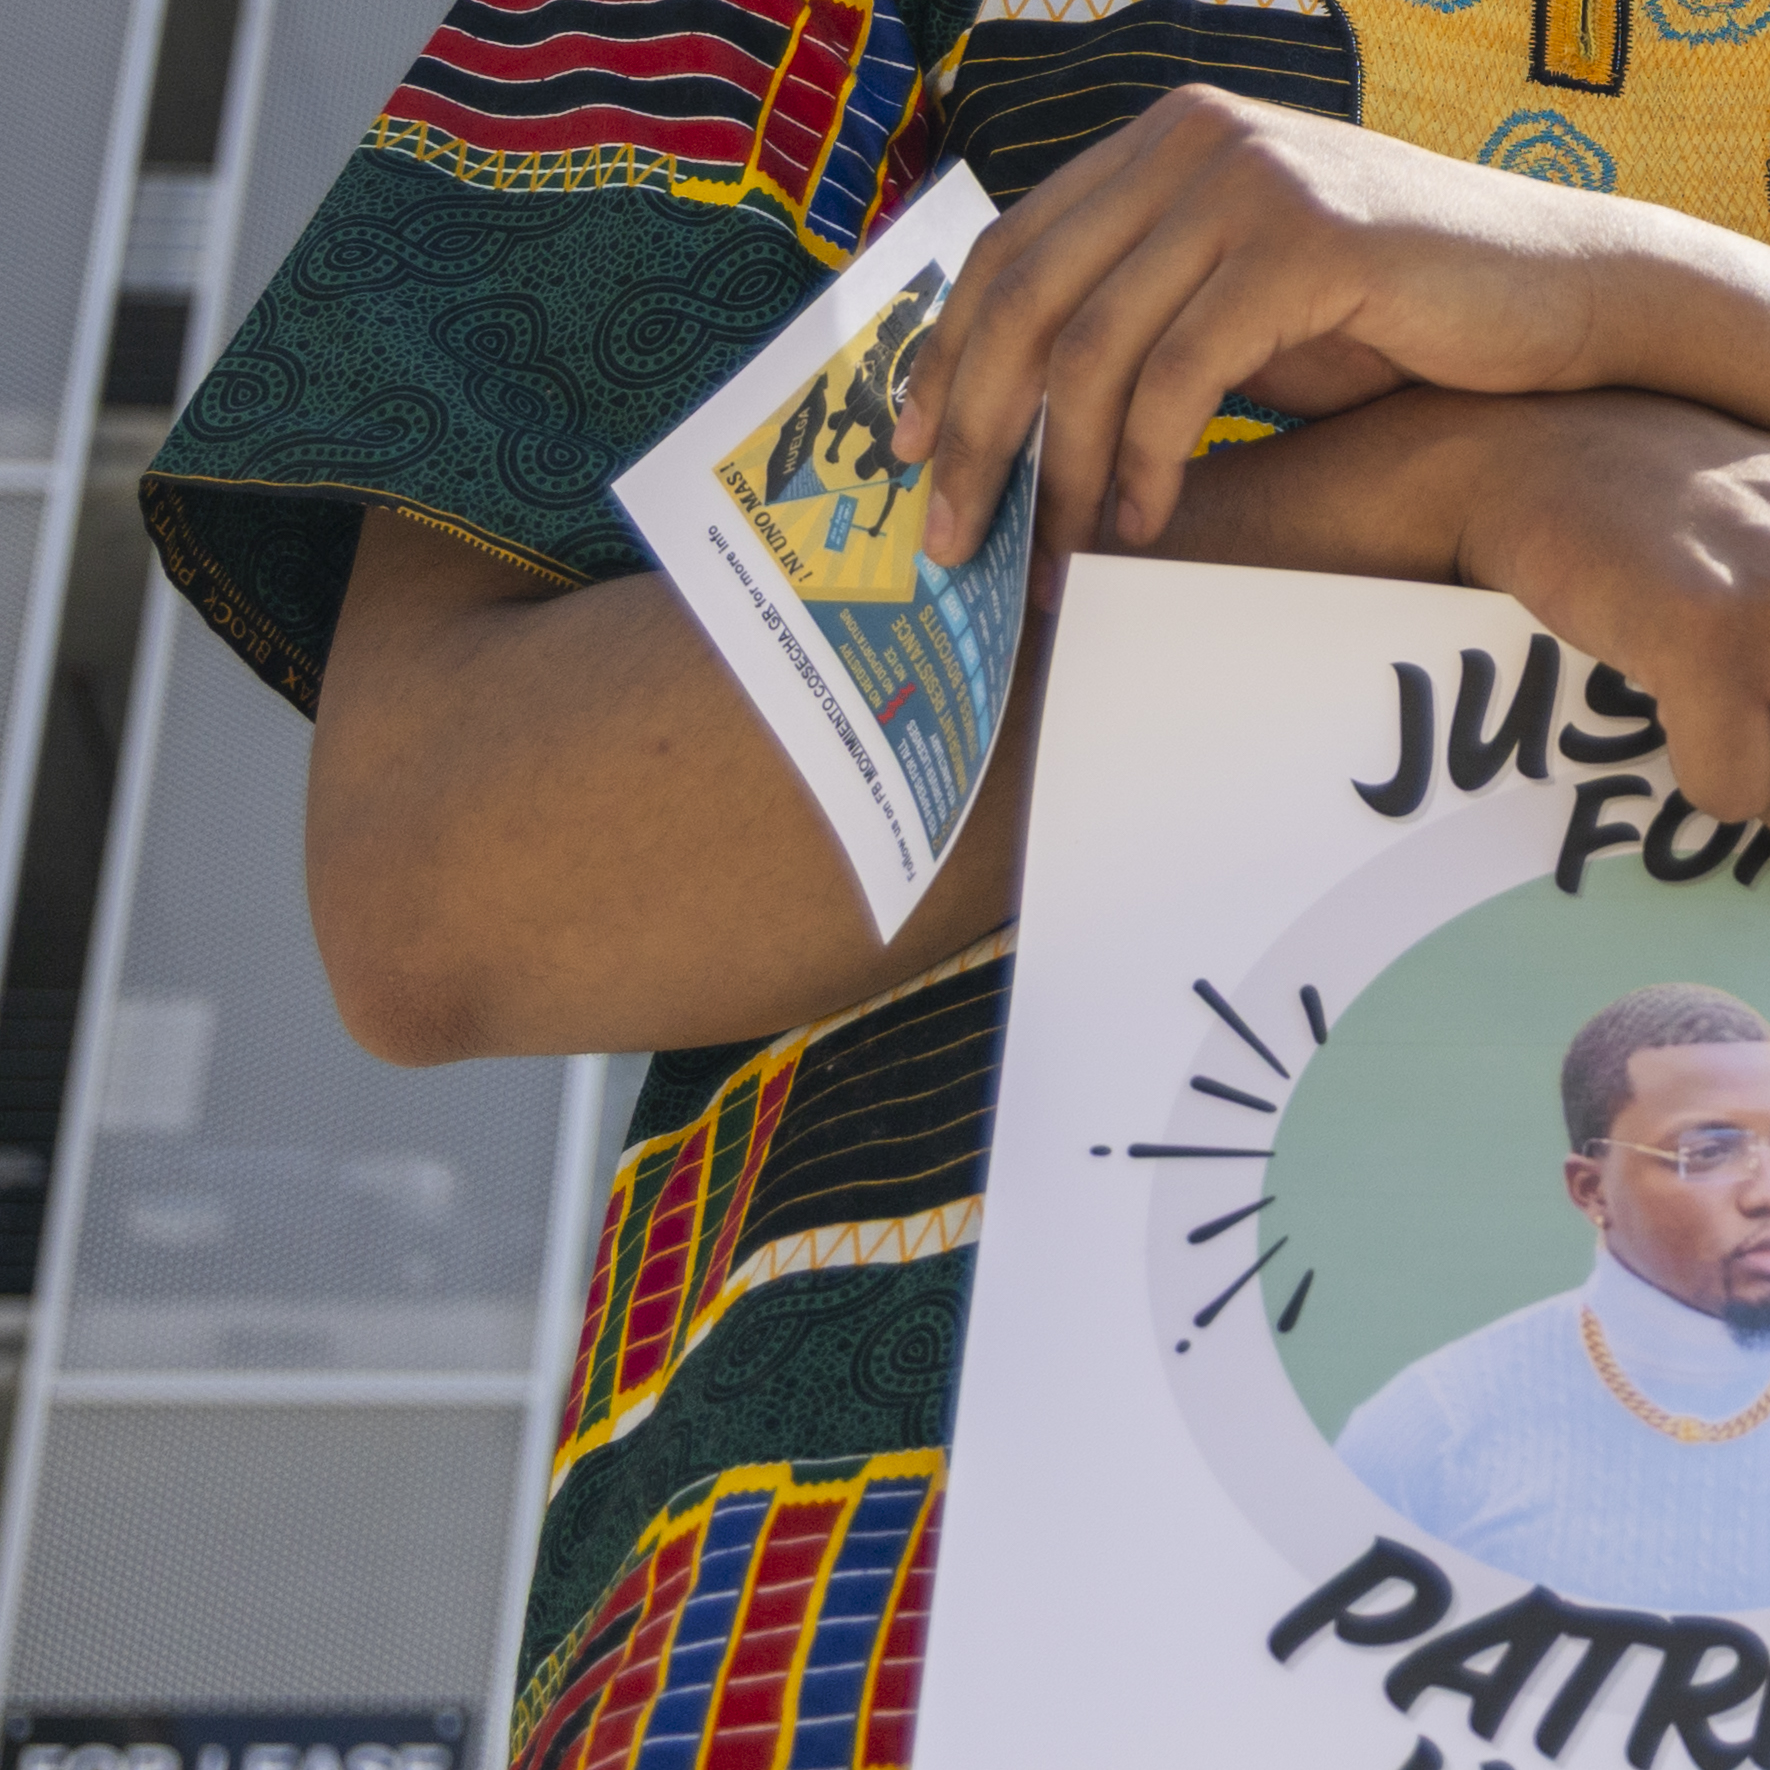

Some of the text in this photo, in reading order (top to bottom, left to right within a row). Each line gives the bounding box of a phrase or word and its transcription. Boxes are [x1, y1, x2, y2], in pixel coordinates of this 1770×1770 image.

[782, 405, 810, 475] HUELGA
[725, 469, 763, 513] MAS
[752, 509, 788, 552] UNO
[778, 548, 804, 575] NI
[838, 607, 895, 695] NO DEPORTATIONS
[838, 641, 883, 708] NO REGISTRY
[882, 645, 908, 682] NO ICE
[890, 612, 946, 714] RESISTANCE
[917, 603, 962, 690] BOYCOTTS
[704, 523, 917, 882] Follow us on FB MOVIMIENTO COSECHA GR for more info
[904, 717, 933, 770] LICENSES
[928, 732, 953, 789] SANCTUARY
[896, 736, 938, 838] YES PAPERS FOR ALL
[924, 764, 943, 803] DRIVER
